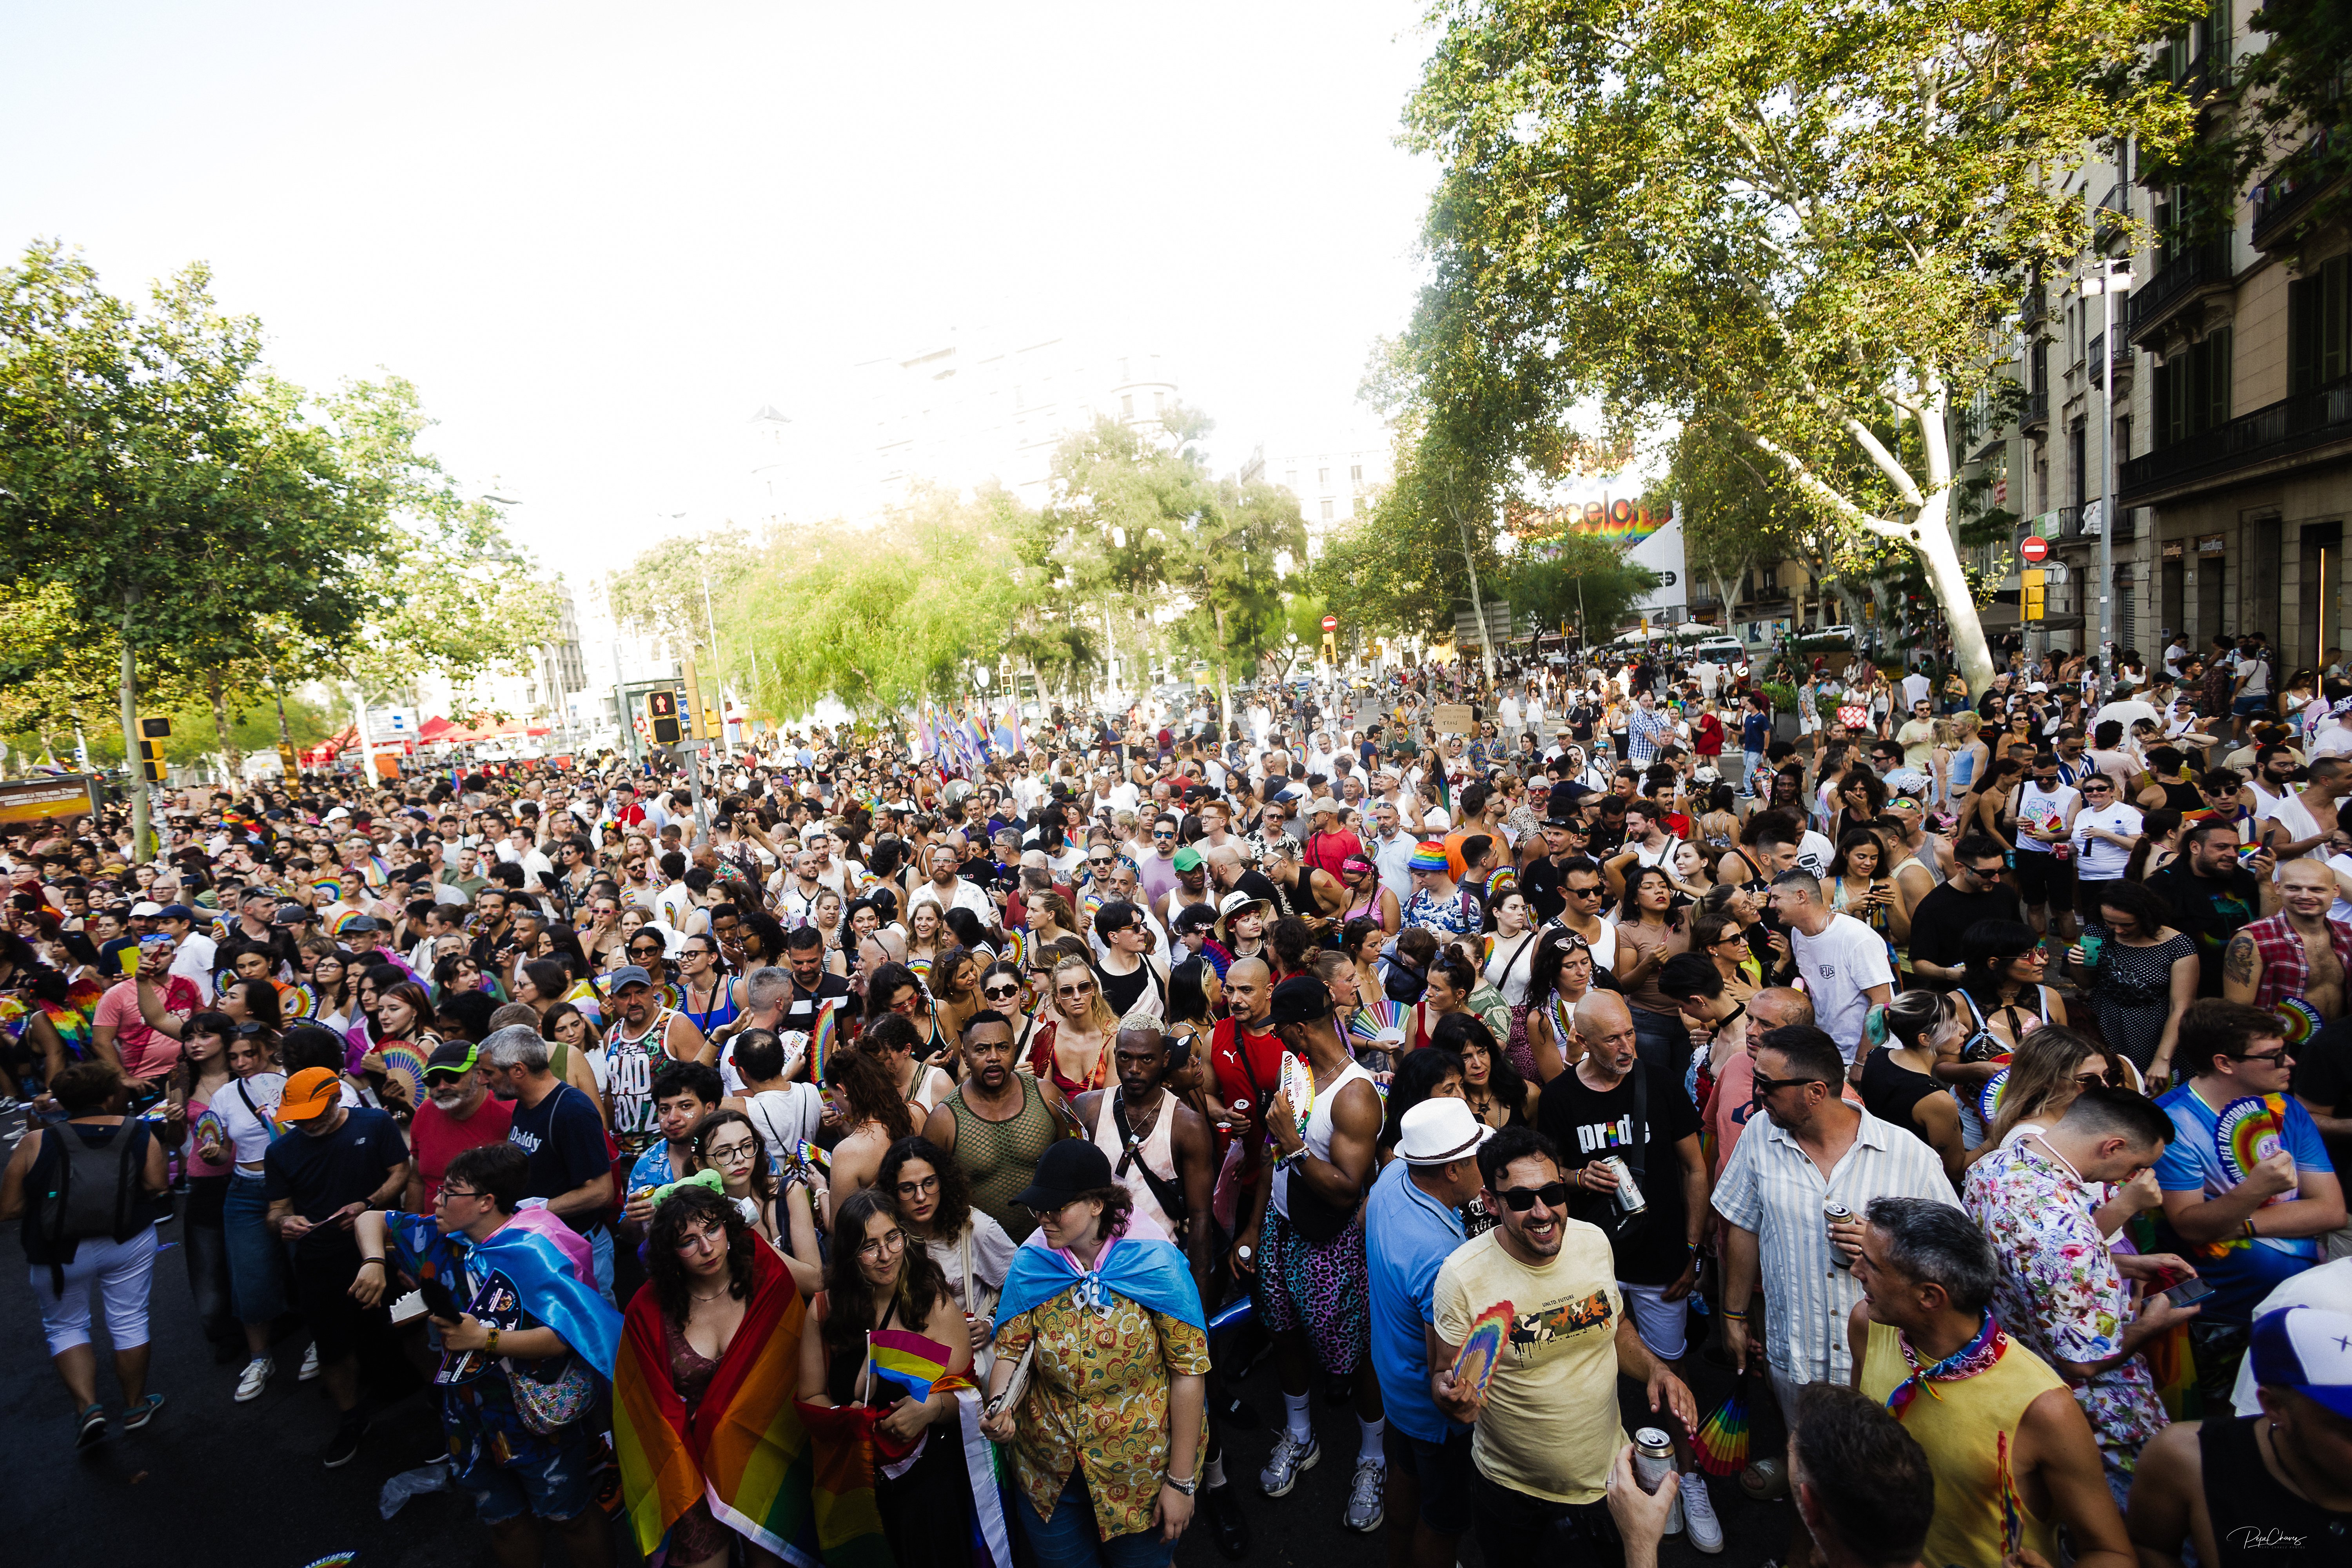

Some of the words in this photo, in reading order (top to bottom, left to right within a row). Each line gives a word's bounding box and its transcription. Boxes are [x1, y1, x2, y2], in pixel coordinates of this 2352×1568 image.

[1488, 867, 1512, 881] TRANSFORMAR
[1820, 966, 1834, 977] DEUS
[2287, 998, 2311, 1013] ORGULL
[2309, 1013, 2319, 1024] PER
[1557, 1022, 1568, 1039] RGULL
[606, 1053, 651, 1095] BAD
[1284, 1055, 1293, 1087] ORGULL
[1301, 1062, 1309, 1079] CON
[1986, 1082, 2000, 1096] PER
[615, 1093, 660, 1133] OYZ
[1984, 1096, 1996, 1120] ORGULL
[2218, 1101, 2260, 1142] TRANSFORMAR
[510, 1126, 542, 1152] Daddy
[2220, 1145, 2235, 1161] PER
[2227, 1162, 2247, 1183] GULL
[1558, 1294, 1574, 1303] FUTURE
